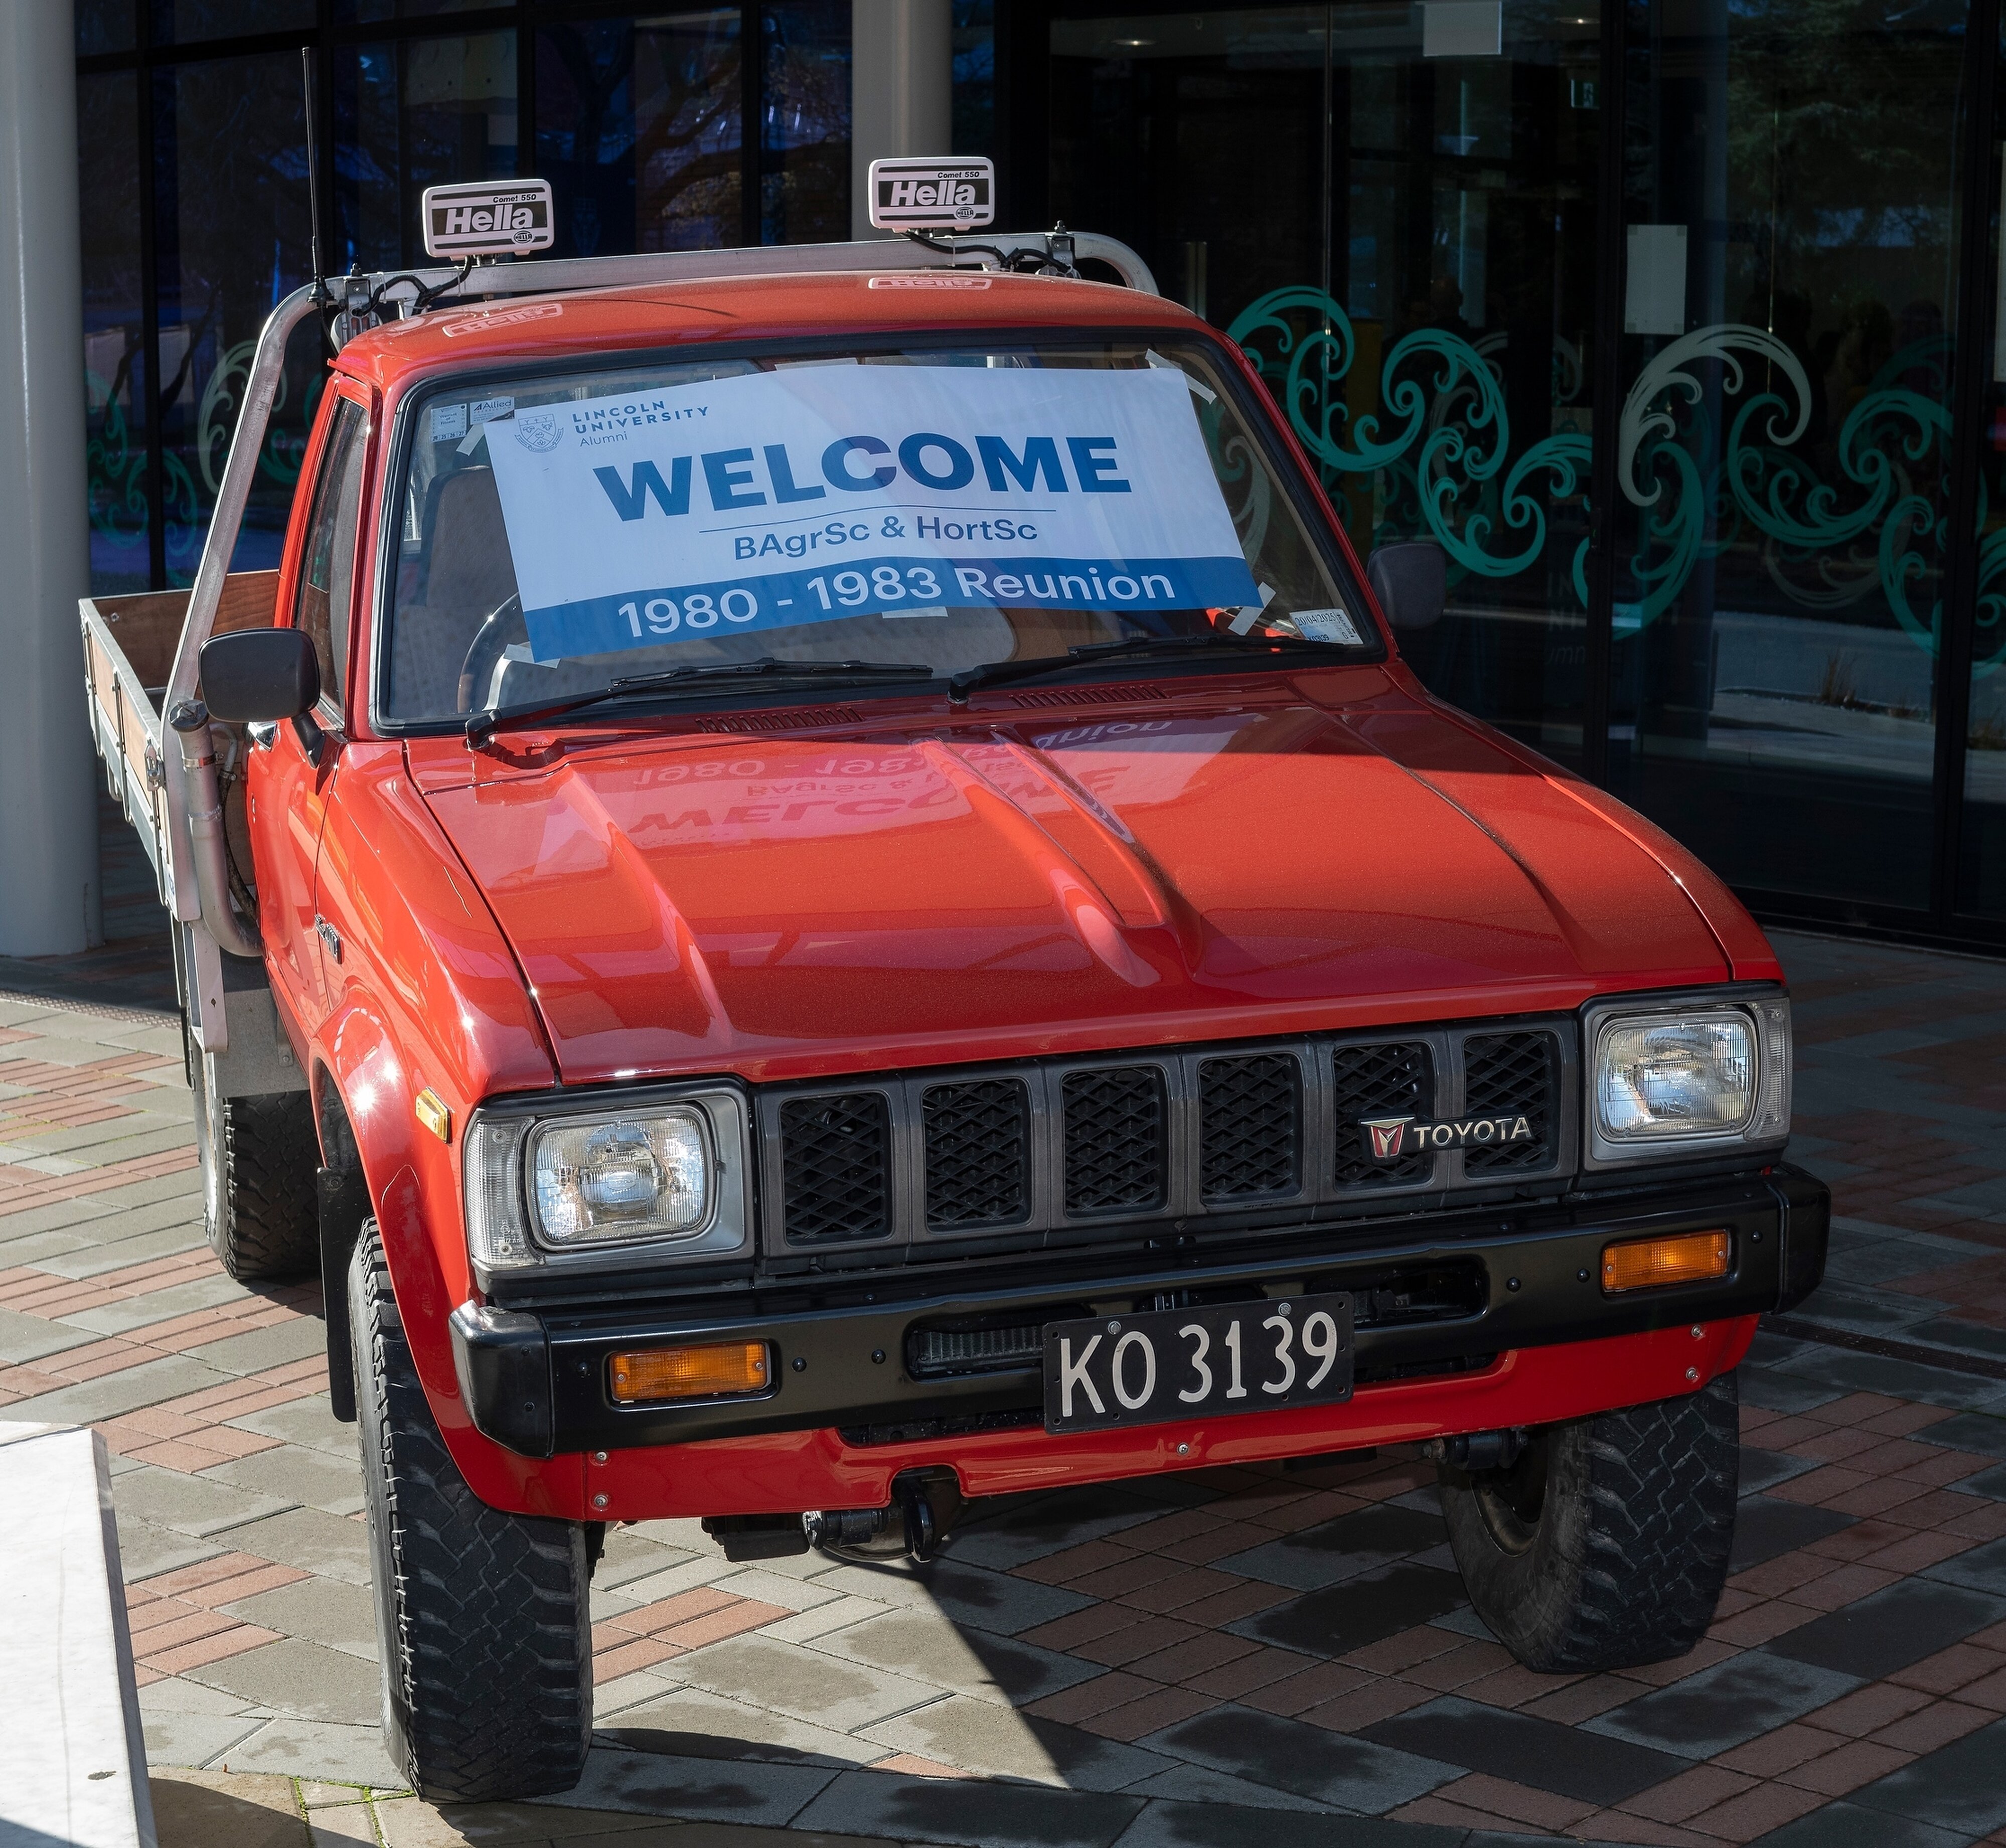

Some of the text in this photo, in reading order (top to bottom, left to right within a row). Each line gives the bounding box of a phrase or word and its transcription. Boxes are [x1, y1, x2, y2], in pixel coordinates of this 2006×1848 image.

[493, 195, 518, 203] Comet
[890, 180, 976, 207] Hella
[445, 204, 534, 234] Hella
[482, 400, 511, 410] Allied
[572, 400, 665, 423] LINCOLN
[574, 406, 709, 434] UNIVERSITY
[579, 431, 628, 447] Alumni
[592, 432, 1132, 522] WELCOME
[734, 516, 1038, 561] BAgrSc & HortSc
[618, 565, 1176, 638] 1980 - 1983 Reunion
[1413, 1117, 1533, 1149] TOYOTA
[1060, 1311, 1338, 1418] KO 3139
